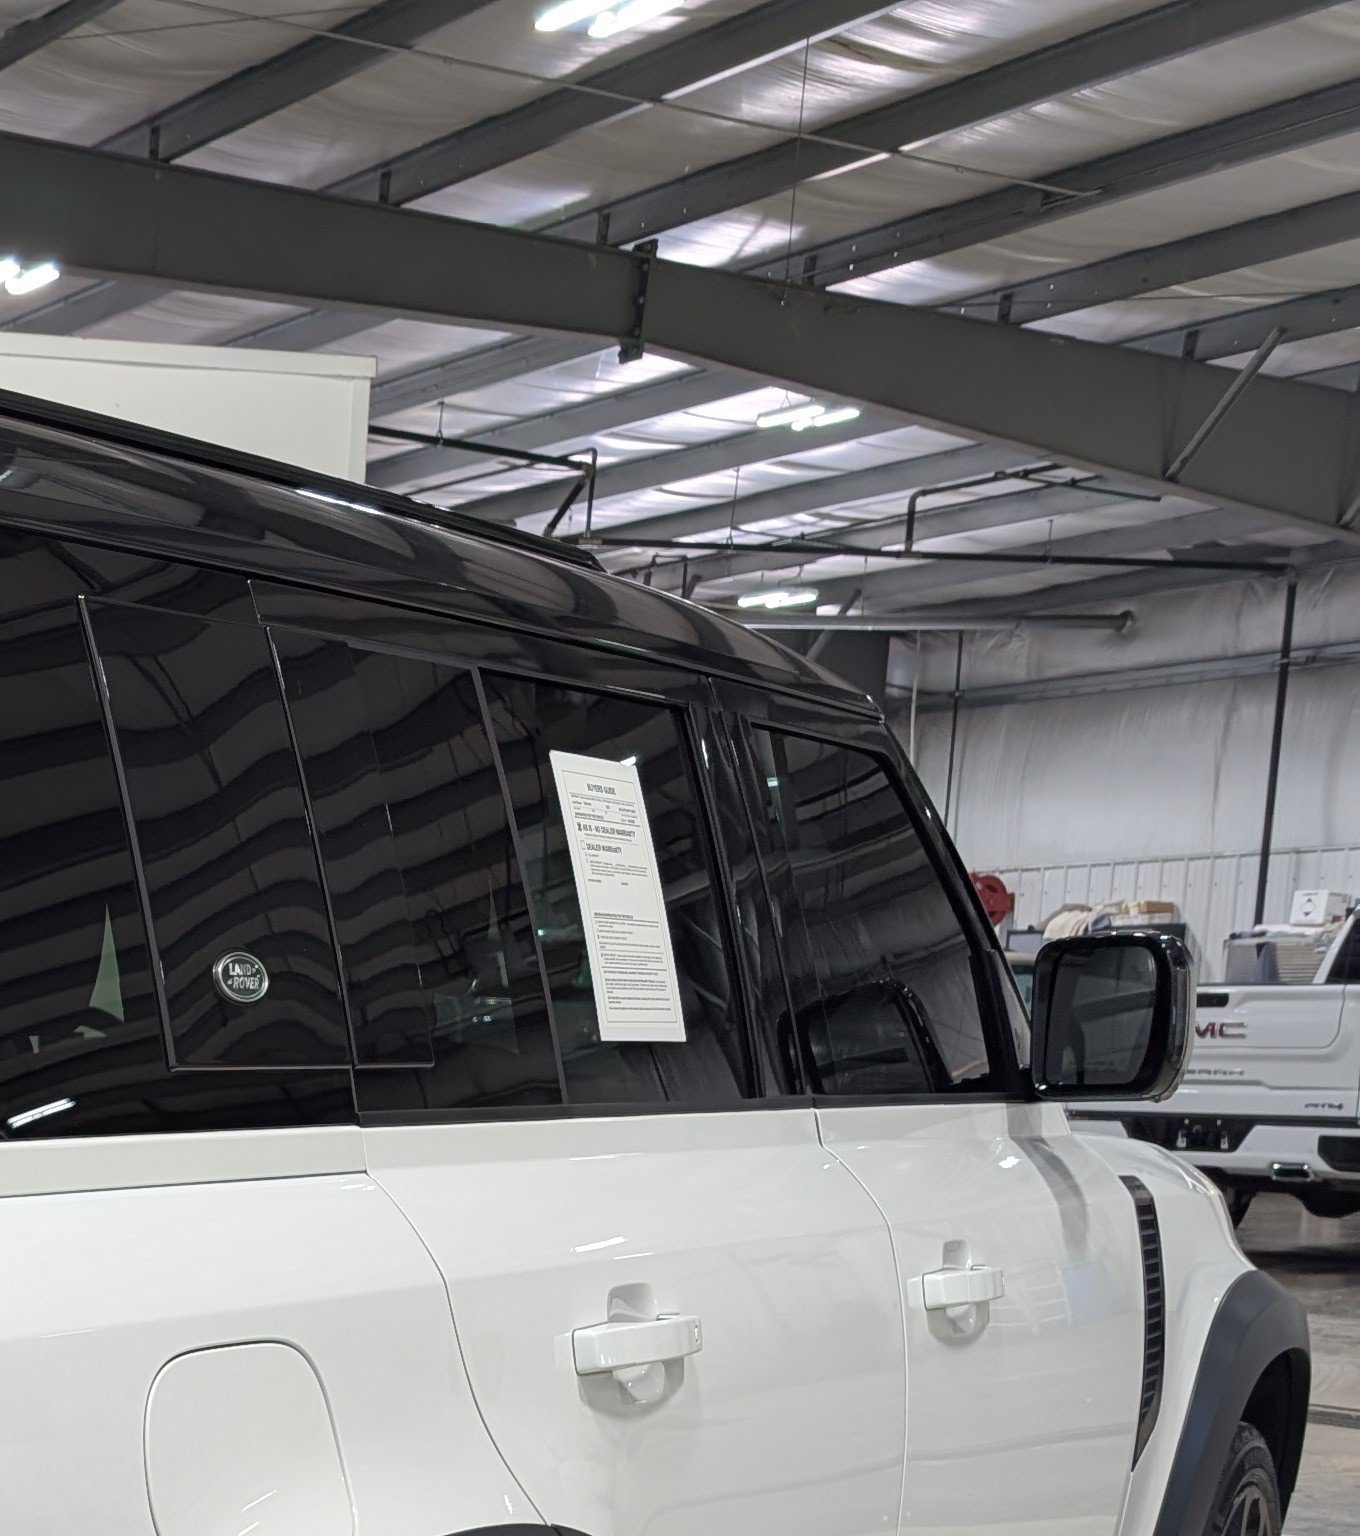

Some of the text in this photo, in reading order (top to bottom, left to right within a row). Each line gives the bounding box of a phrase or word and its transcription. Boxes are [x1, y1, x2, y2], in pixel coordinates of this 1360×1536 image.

[229, 962, 252, 976] LAND
[233, 976, 259, 989] ROVER
[1195, 1021, 1247, 1039] MC
